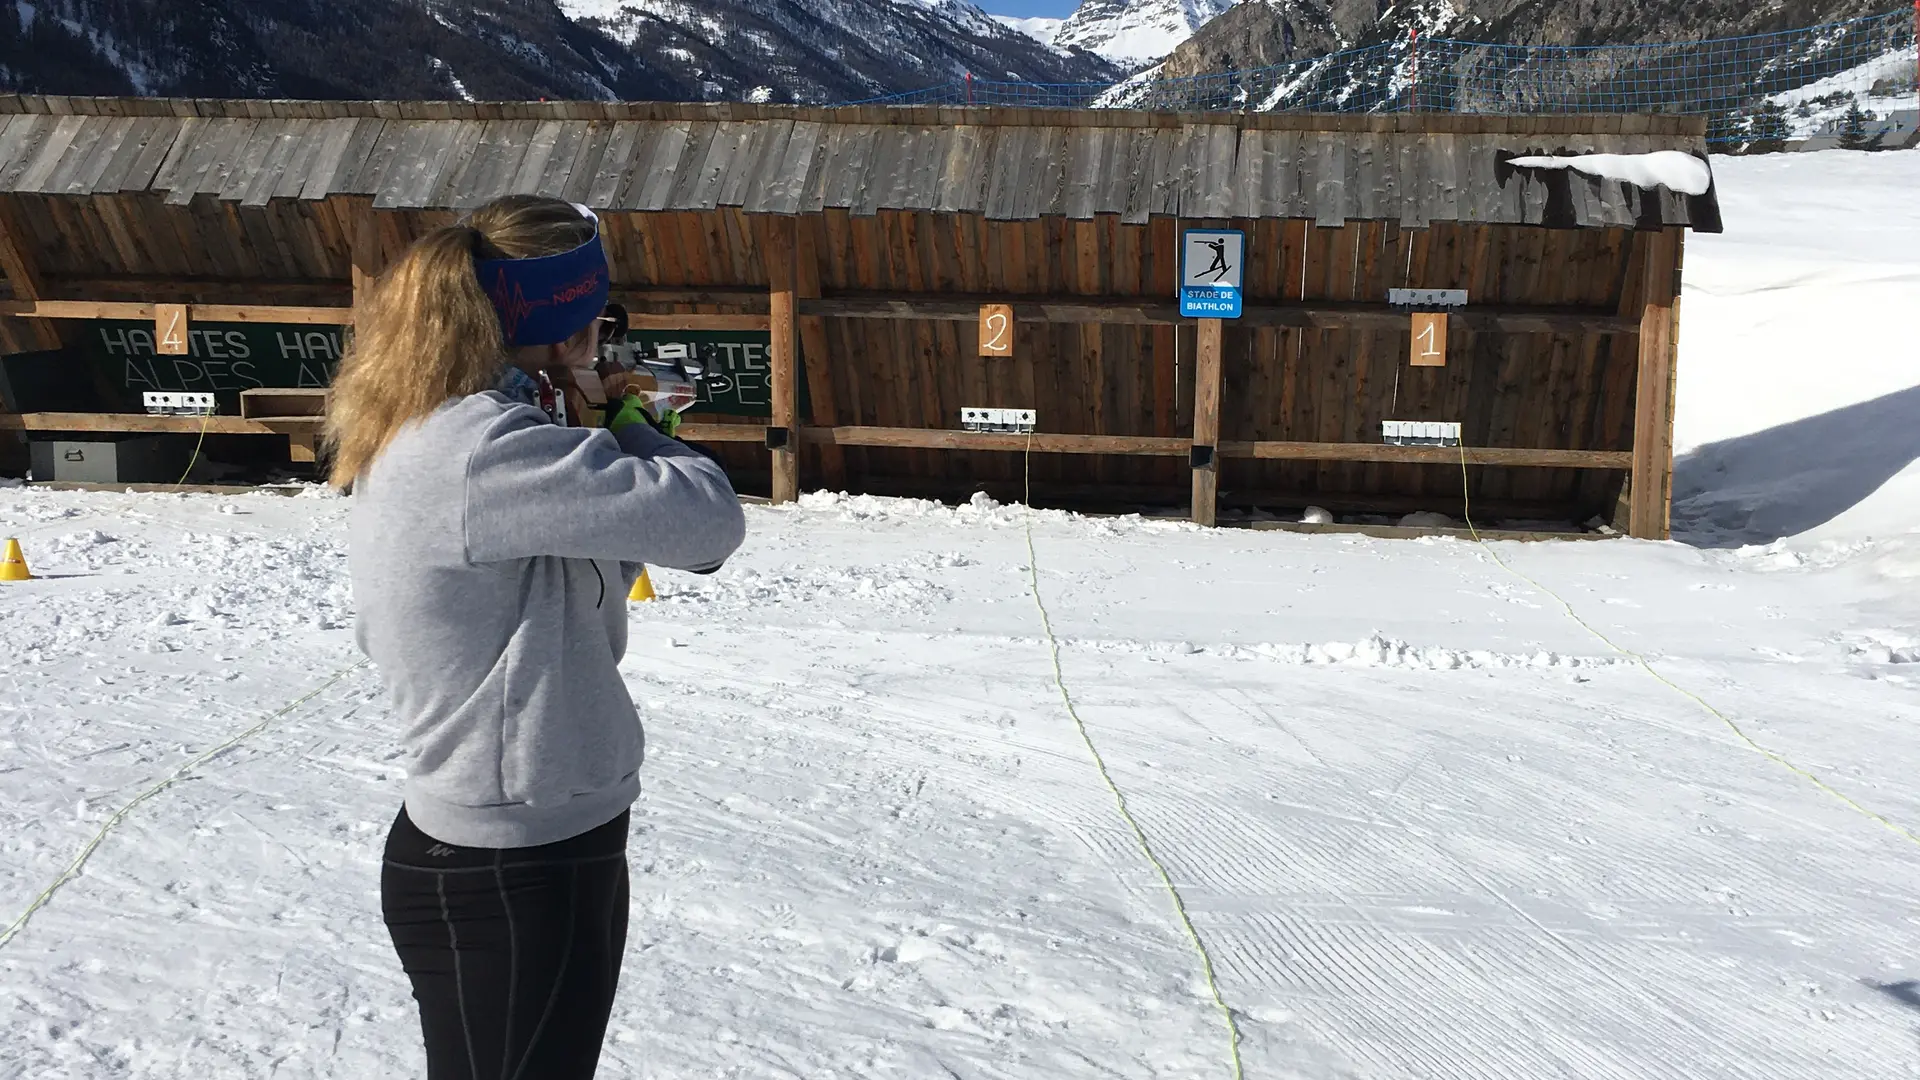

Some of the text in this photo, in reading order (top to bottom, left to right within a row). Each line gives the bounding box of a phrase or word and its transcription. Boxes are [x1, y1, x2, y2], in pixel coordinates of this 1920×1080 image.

[1186, 302, 1234, 311] BIATHLON
[1187, 290, 1234, 299] STADE DE
[100, 328, 251, 359] HATES
[161, 311, 183, 350] 4
[982, 313, 1007, 350] 2
[1416, 321, 1440, 356] 1
[125, 358, 264, 391] ALPES
